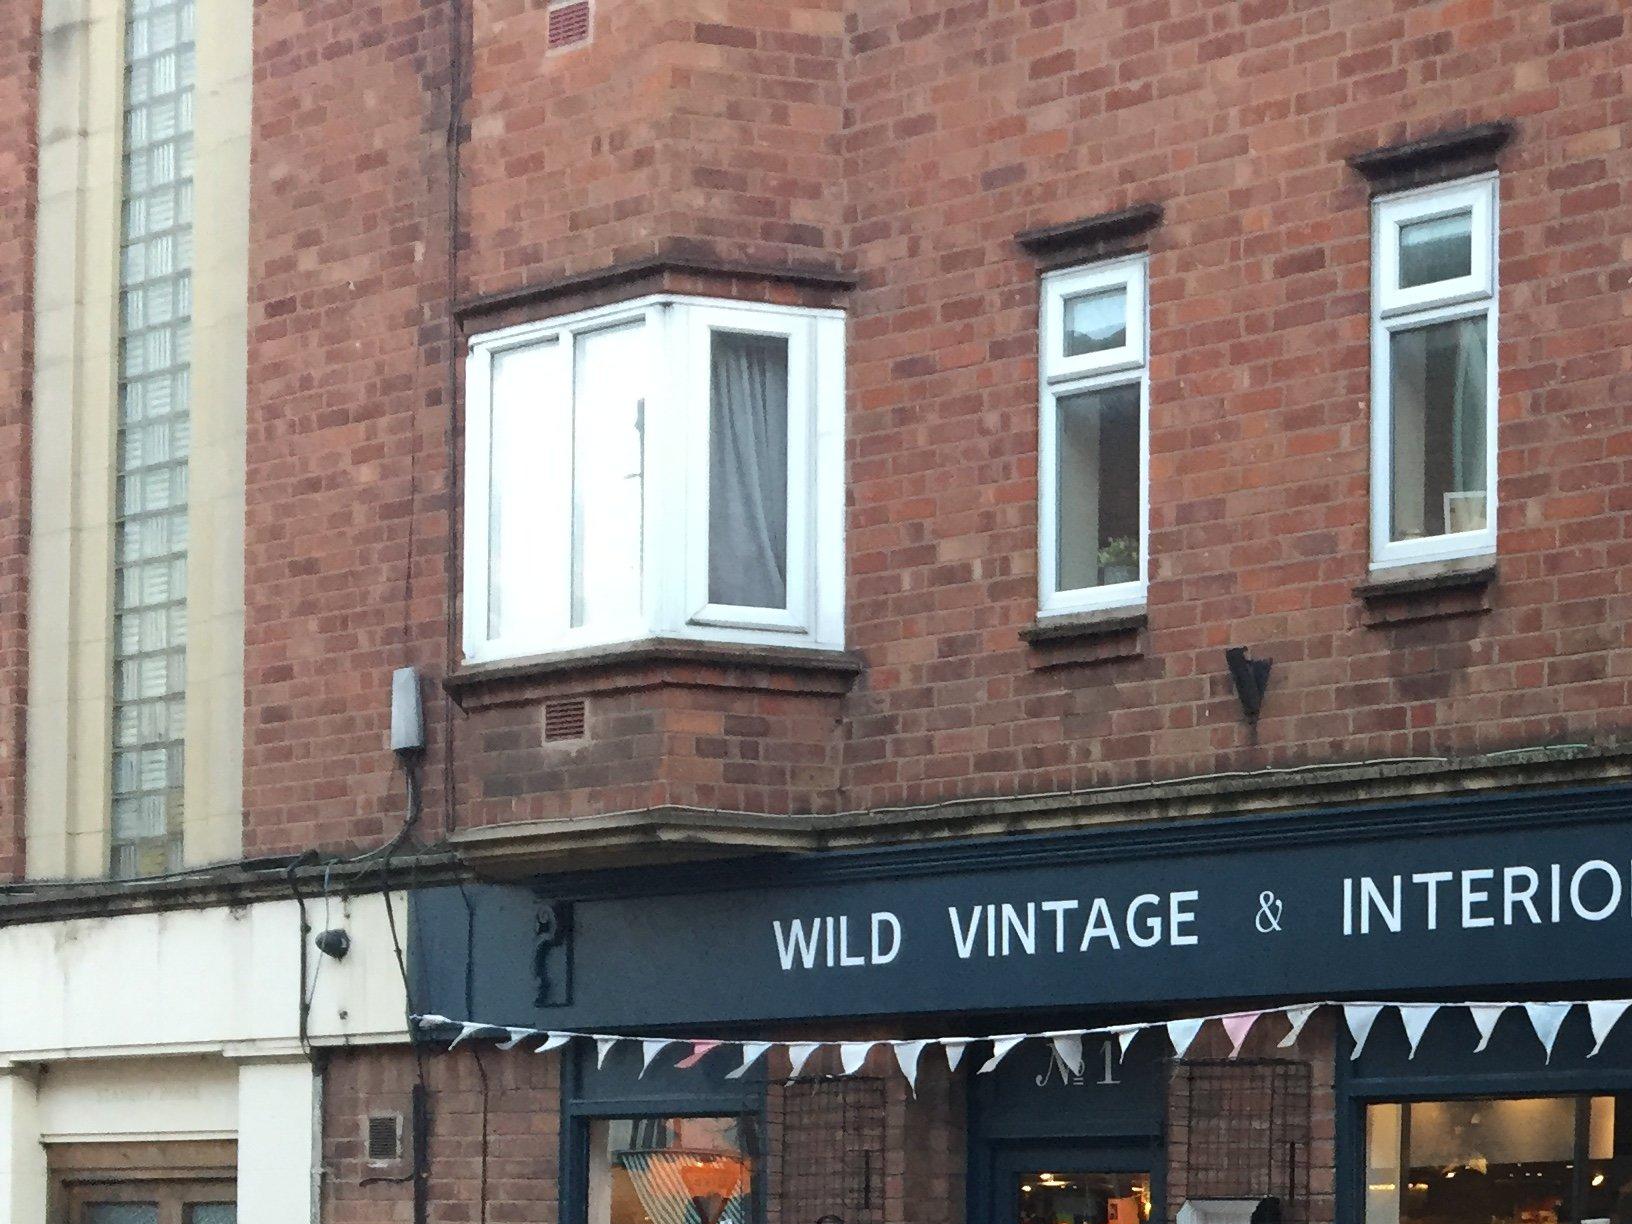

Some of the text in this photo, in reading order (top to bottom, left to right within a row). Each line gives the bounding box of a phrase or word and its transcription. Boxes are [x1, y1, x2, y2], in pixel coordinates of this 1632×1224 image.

[772, 911, 902, 970] WILD
[948, 890, 1200, 959] VINTAGE
[1255, 891, 1283, 933] &
